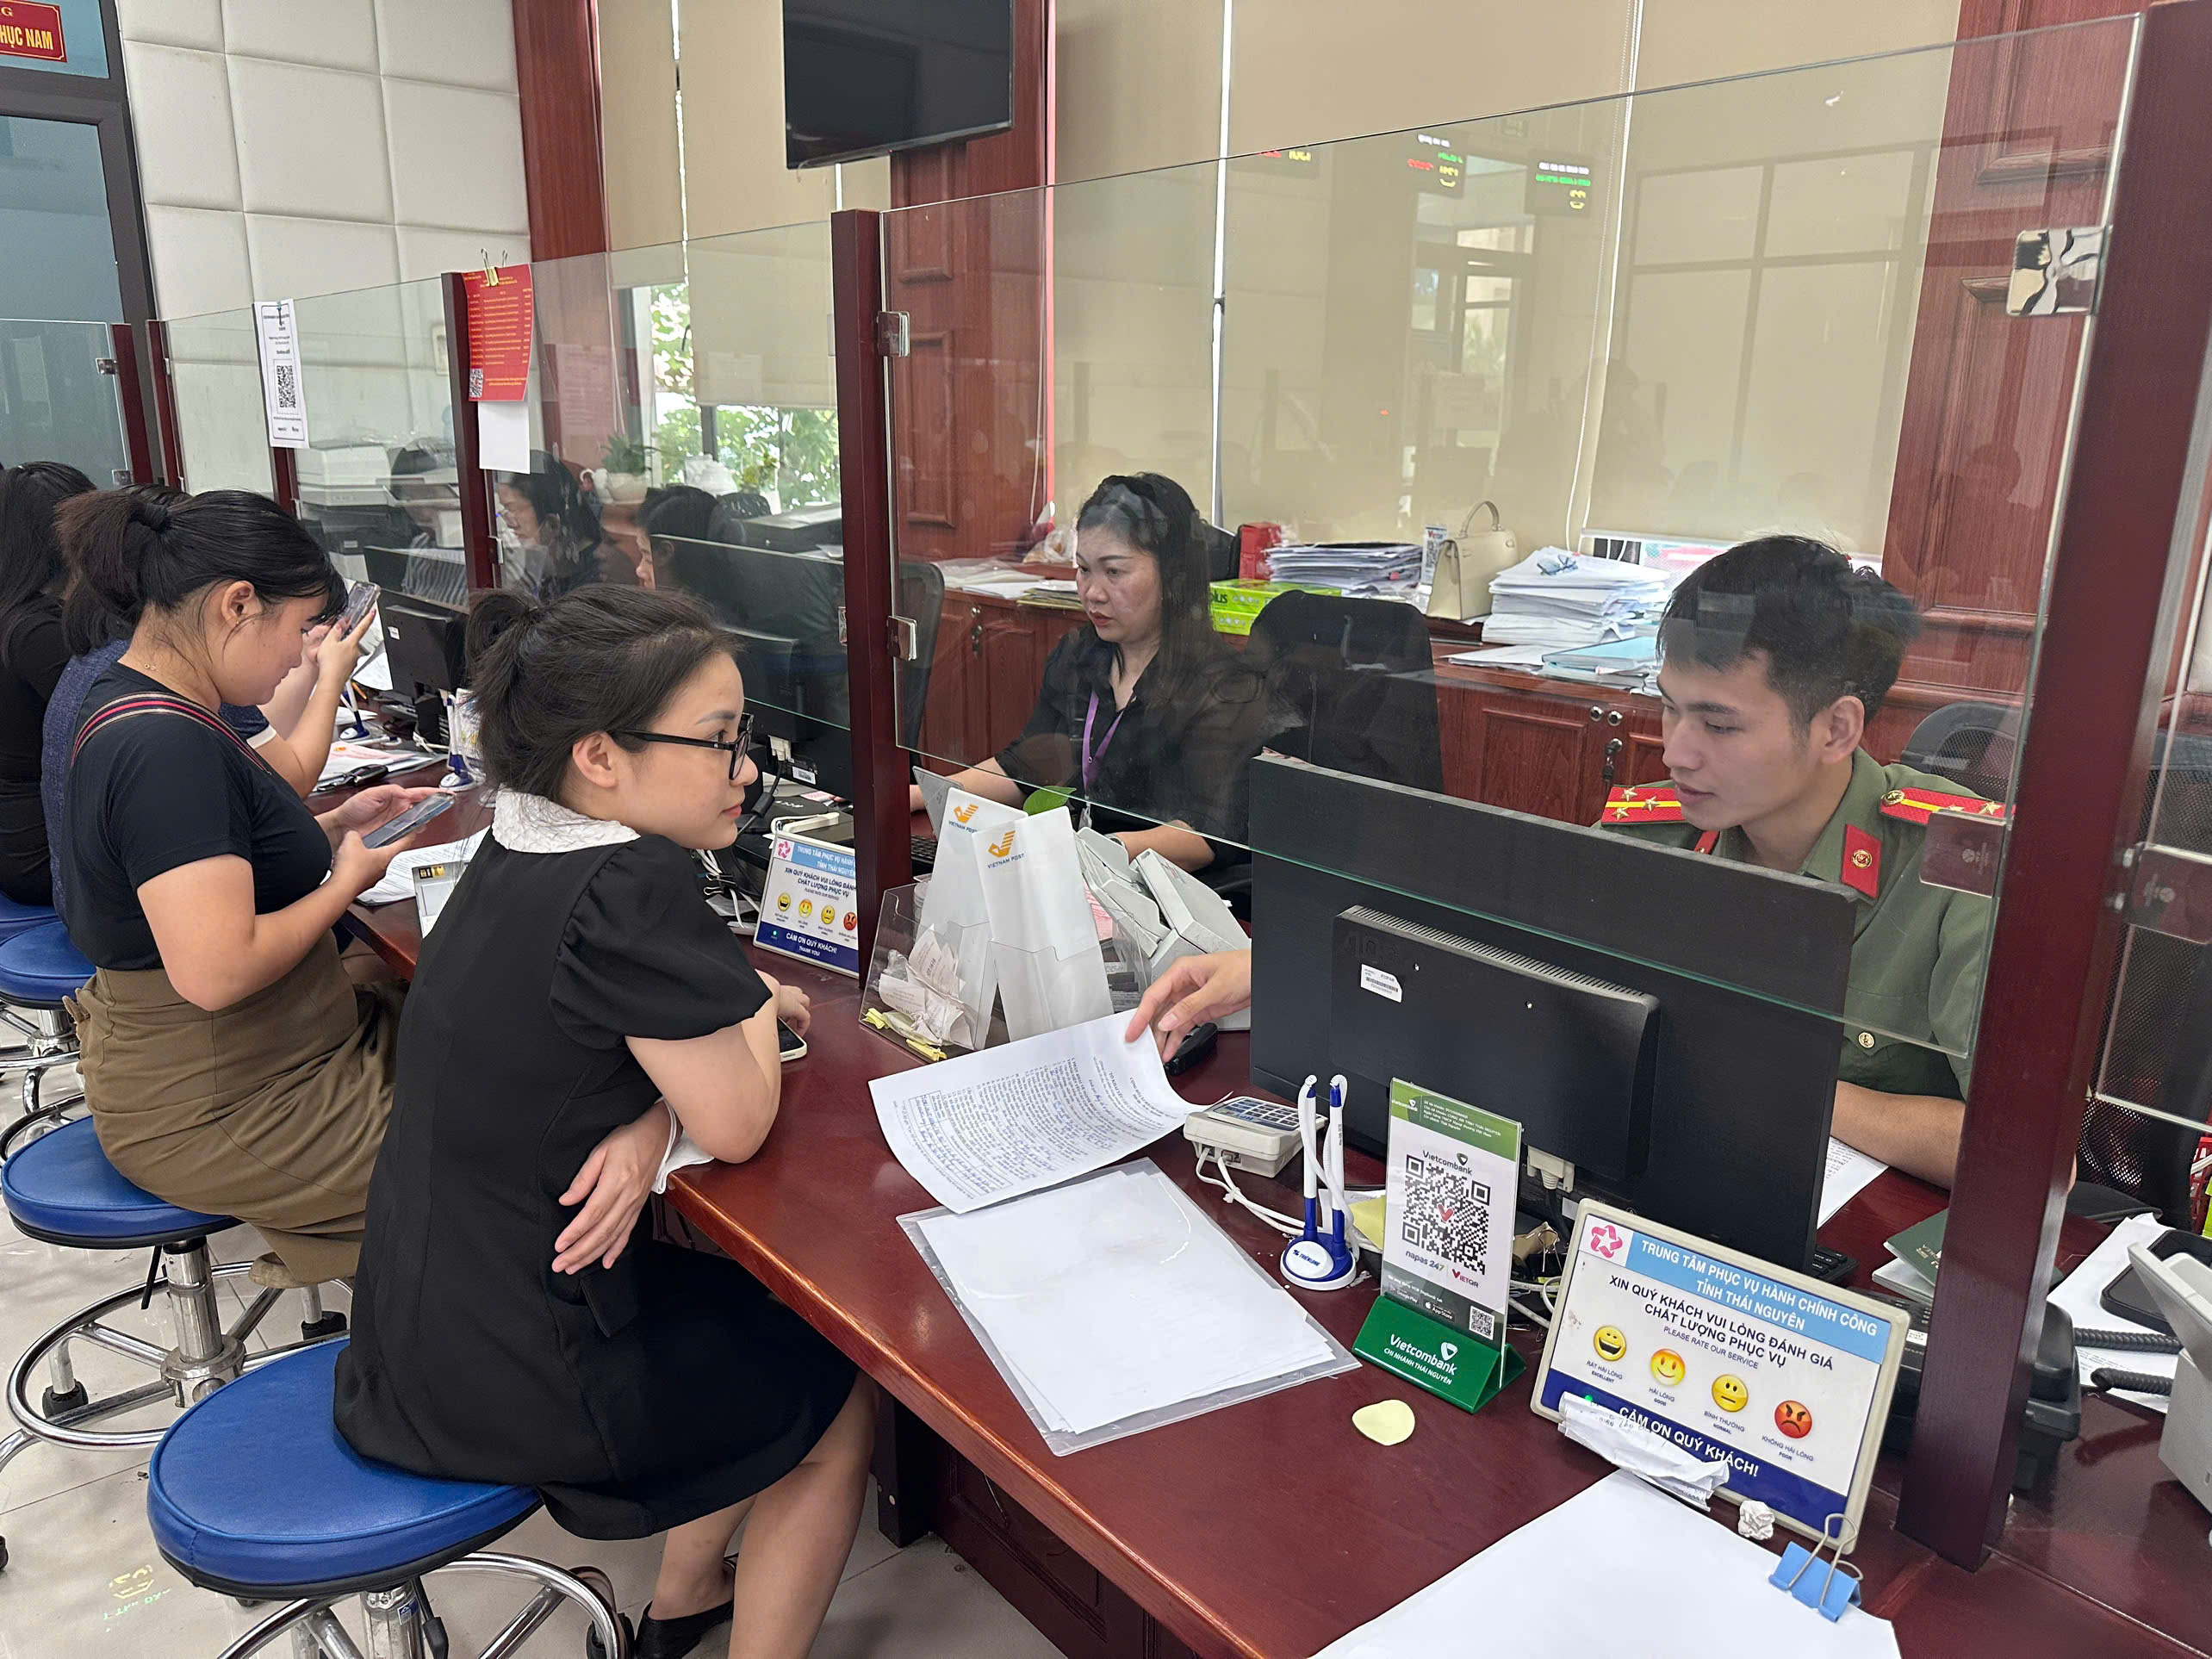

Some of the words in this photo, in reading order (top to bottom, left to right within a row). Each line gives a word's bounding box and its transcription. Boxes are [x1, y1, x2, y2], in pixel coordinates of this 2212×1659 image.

[25, 28, 53, 50] NAM
[798, 846, 811, 855] TRUNG
[987, 858, 1010, 869] VIETNAM
[804, 872, 820, 882] KHÁCH
[829, 885, 842, 897] PHỤC
[806, 939, 817, 948] QUÝ
[817, 943, 838, 954] KHÁCH!
[1423, 1150, 1473, 1176] Vietcombank
[1406, 1251, 1428, 1266] napas
[1429, 1259, 1445, 1271] 247
[1642, 1240, 1680, 1264] TRUNG
[1683, 1254, 1706, 1274] TÂM
[1708, 1265, 1741, 1286] PHỤC
[1743, 1277, 1760, 1293] VỤ
[1762, 1284, 1796, 1308] HÀNH
[1799, 1297, 1837, 1322] CHÍNH
[1840, 1311, 1878, 1337] CÔNG
[1696, 1277, 1724, 1301] TỈNH
[1725, 1291, 1753, 1312] THÁI
[1754, 1303, 1805, 1331] NGUYÊN
[1432, 1307, 1442, 1315] App
[1442, 1310, 1453, 1320] Store
[1609, 1275, 1630, 1291] XIN
[1632, 1284, 1658, 1301] QUÝ
[1660, 1294, 1704, 1320] KHÁCH
[1706, 1312, 1727, 1329] VUI
[1729, 1321, 1767, 1344] LÒNG
[1768, 1336, 1807, 1360] ĐÁNH
[1810, 1352, 1834, 1371] GIÁ
[1663, 1327, 1690, 1342] PLEASE
[1691, 1336, 1709, 1350] RATE
[1710, 1345, 1727, 1357] OUR
[1727, 1351, 1759, 1370] SERVICE
[1680, 1317, 1726, 1343] LƯỢNG
[1729, 1336, 1766, 1358] PHỤC
[1768, 1351, 1786, 1368] VỤ
[1390, 1333, 1458, 1376] Vietcombank
[1384, 1348, 1394, 1357] CHI
[1394, 1351, 1415, 1368] NHÁNH
[1414, 1361, 1427, 1374] THÁI
[1427, 1369, 1452, 1386] NGUYÊN
[1591, 1370, 1615, 1383] EXCELLENT
[1653, 1398, 1667, 1407] GOOD
[1713, 1423, 1732, 1435] NORMAL
[1619, 1407, 1648, 1428] CẢM
[1650, 1421, 1672, 1439] ƠN
[1674, 1432, 1704, 1451] QUÝ
[1706, 1445, 1759, 1477] KHÁCH!
[1762, 1435, 1784, 1451] KHÔNG
[1779, 1451, 1793, 1462] POOR
